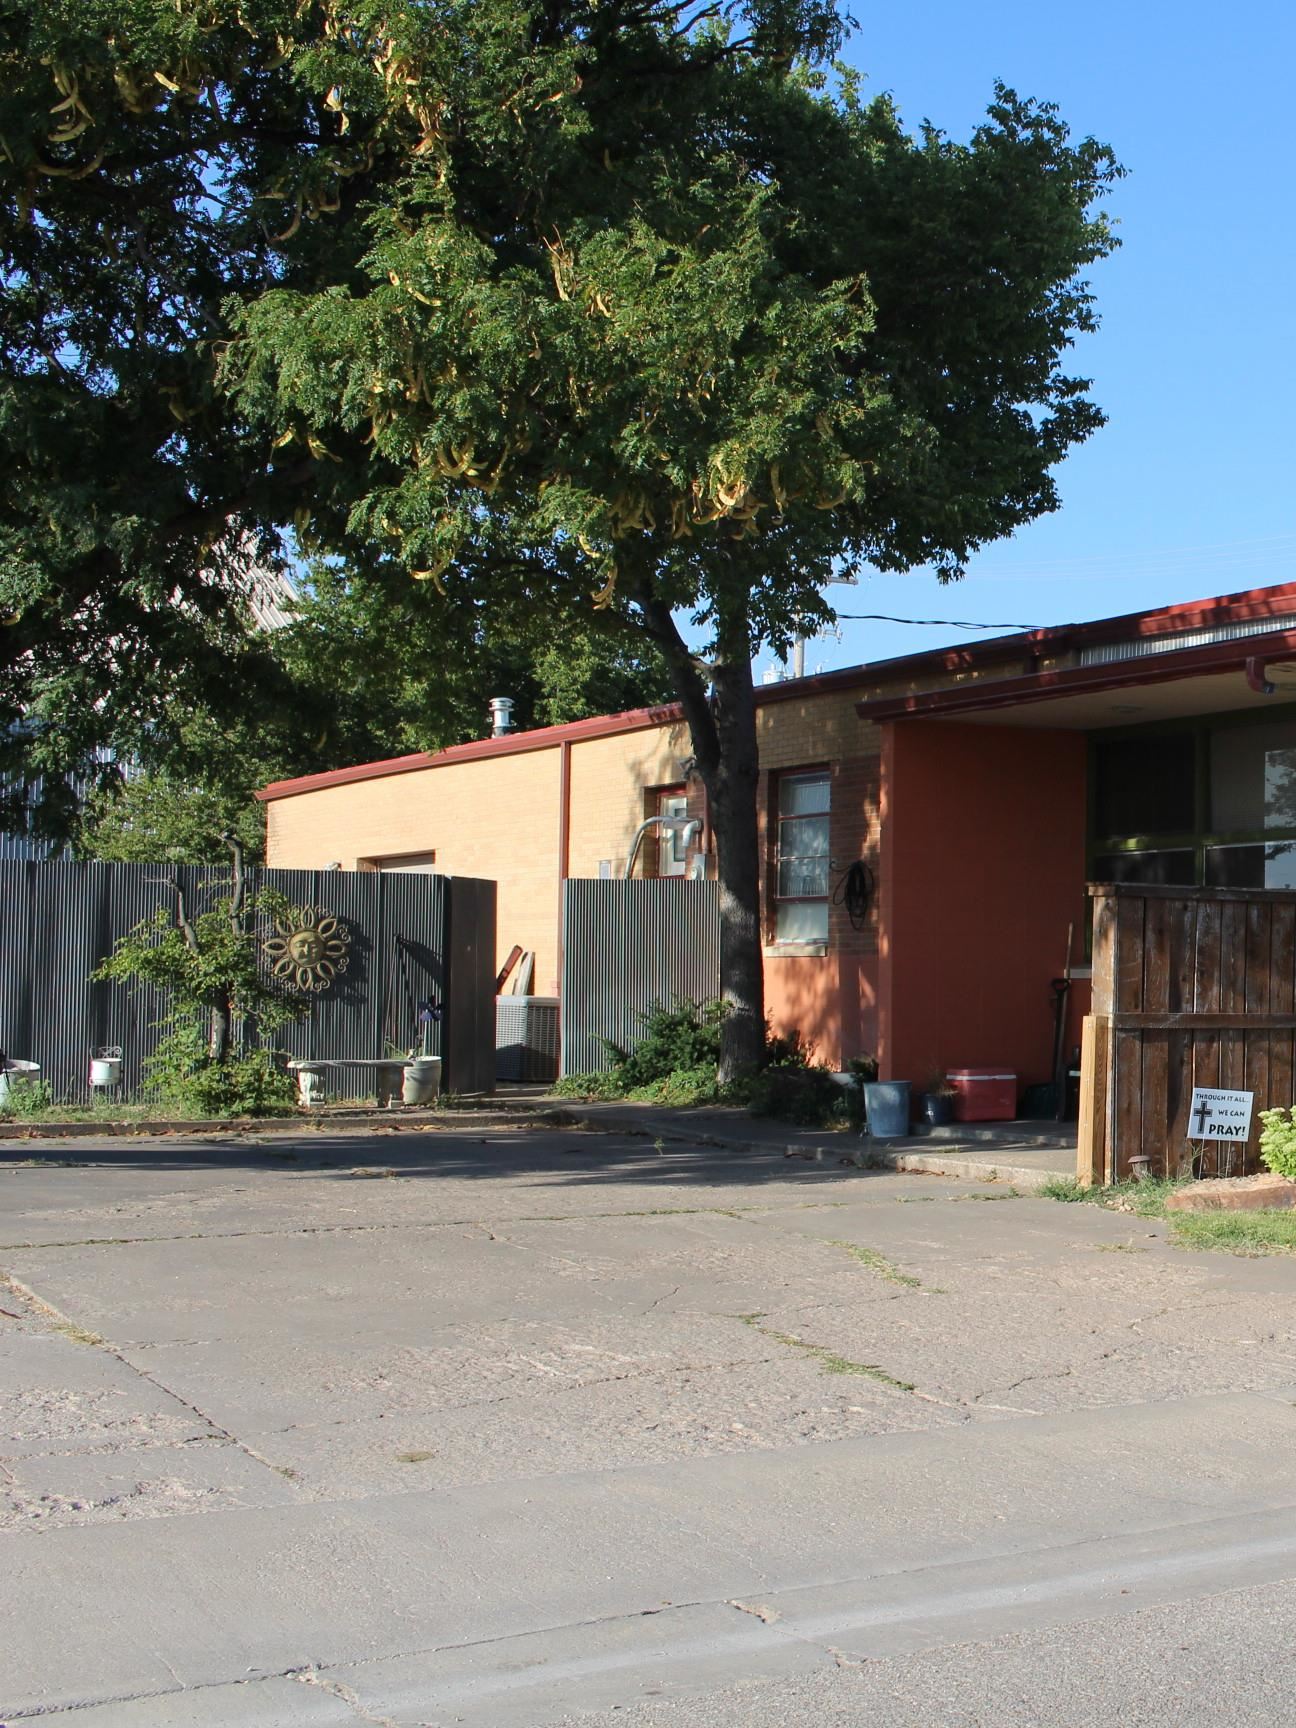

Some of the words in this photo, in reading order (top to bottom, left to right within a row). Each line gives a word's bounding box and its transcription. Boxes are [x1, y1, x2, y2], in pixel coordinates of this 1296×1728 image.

[1196, 1093, 1226, 1101] THROUGH
[1218, 1109, 1229, 1117] WE
[1208, 1124, 1246, 1137] PRAY!
